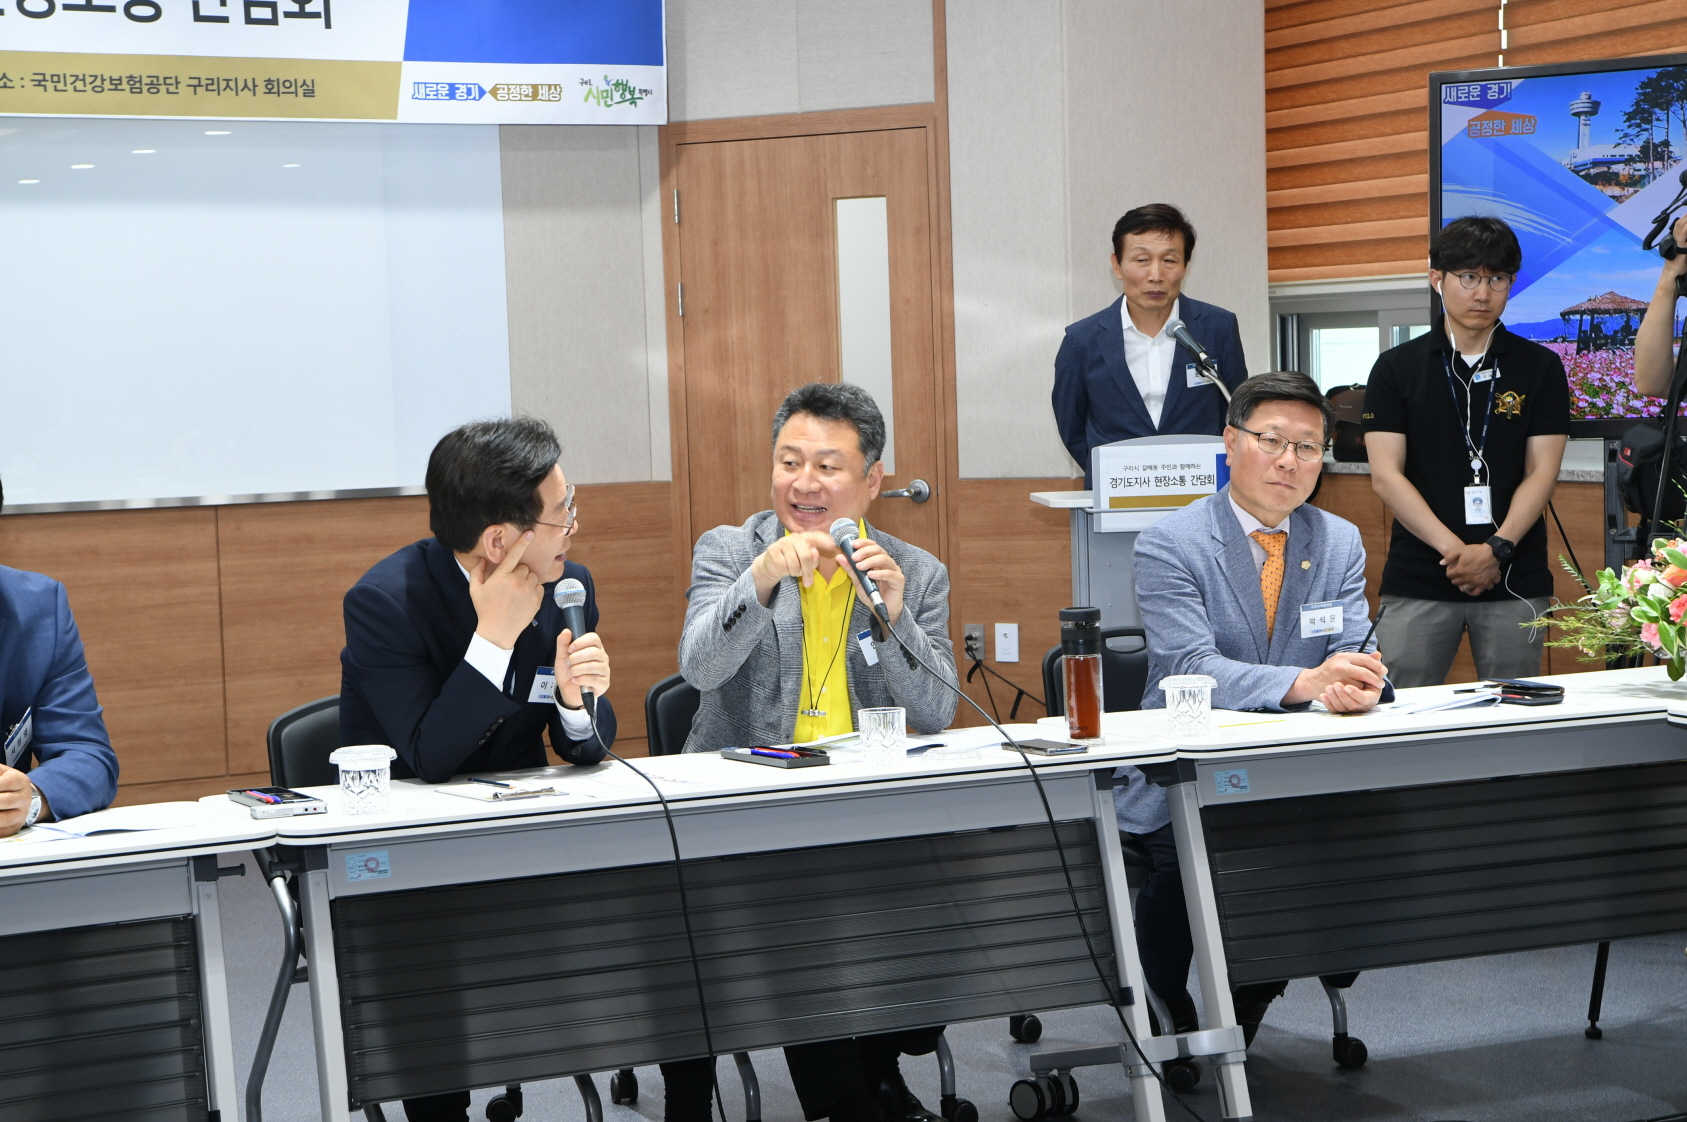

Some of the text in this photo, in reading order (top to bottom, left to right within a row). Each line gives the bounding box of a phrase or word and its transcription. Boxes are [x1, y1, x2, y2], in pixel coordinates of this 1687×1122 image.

[30, 72, 181, 95] 국민건강보험공단
[186, 76, 258, 97] 구리지사
[263, 78, 316, 98] 회의실
[412, 83, 480, 100] 새로운 경기
[496, 84, 562, 101] 공정한 세상
[1444, 82, 1511, 102] 새로운 경기
[1469, 117, 1536, 137] 공정한 세상
[1109, 473, 1215, 489] 경기도지사 현장소통 간담회
